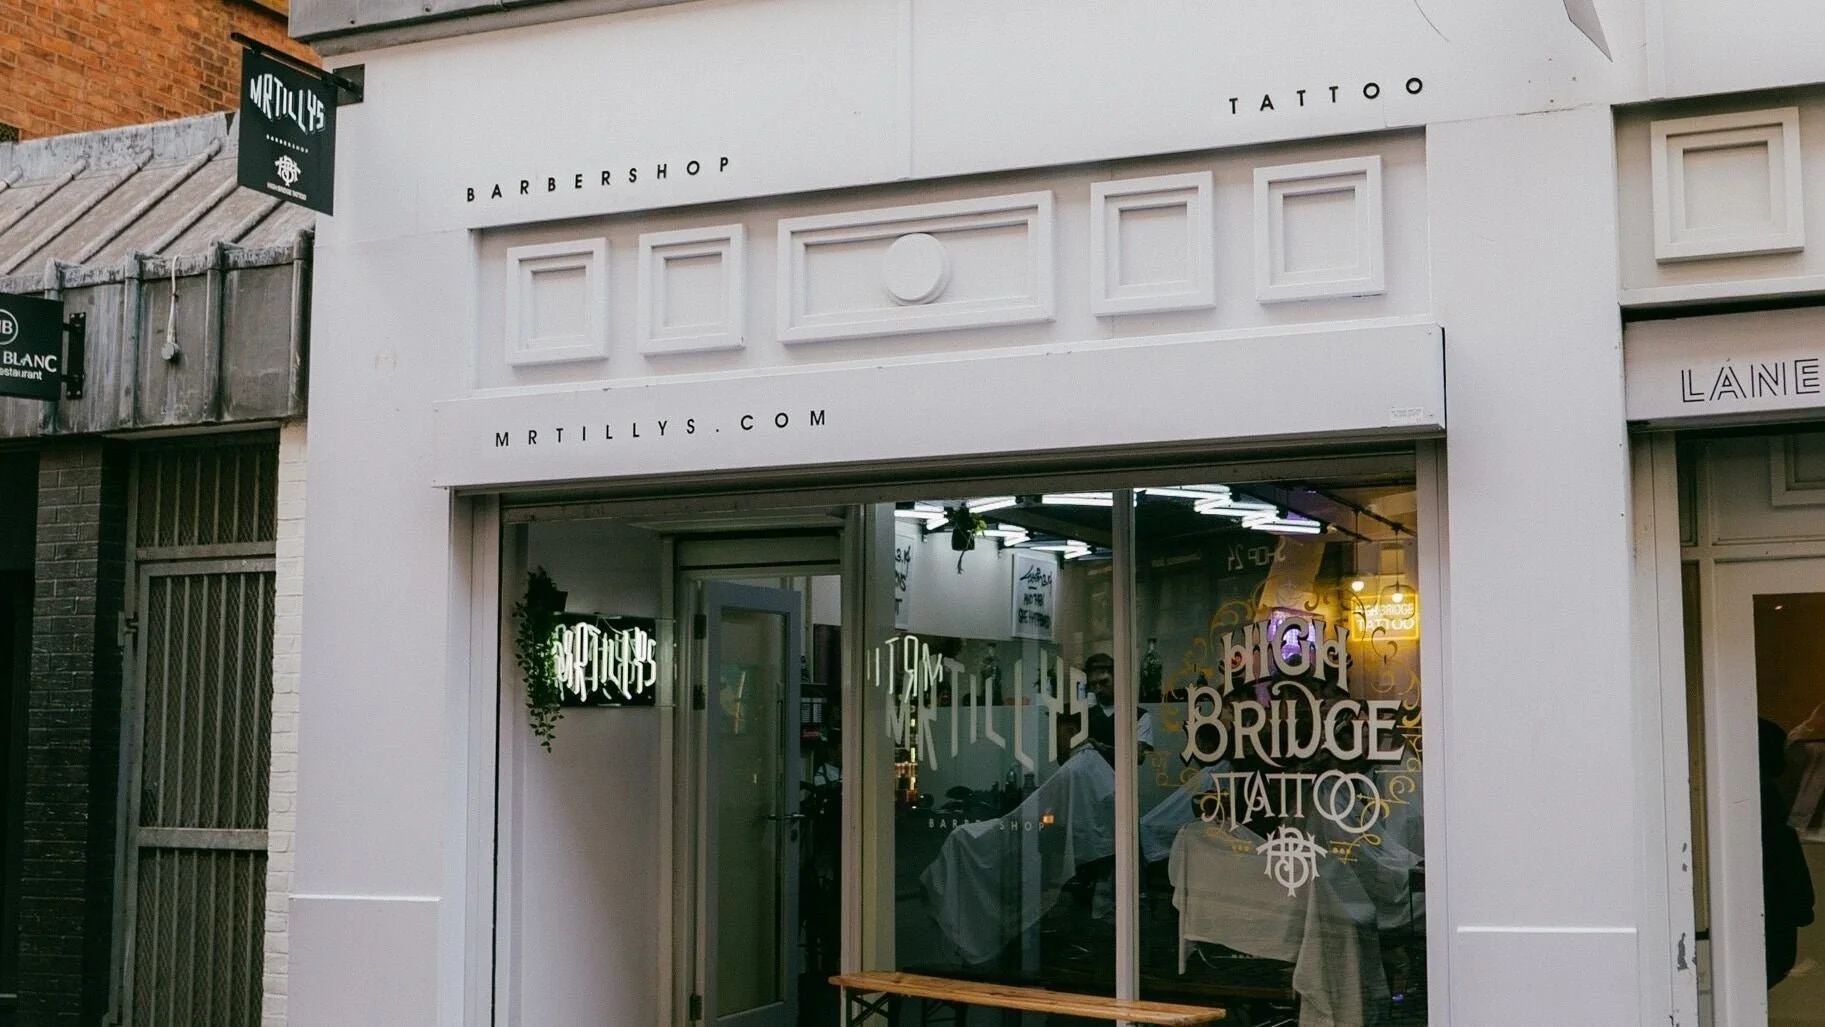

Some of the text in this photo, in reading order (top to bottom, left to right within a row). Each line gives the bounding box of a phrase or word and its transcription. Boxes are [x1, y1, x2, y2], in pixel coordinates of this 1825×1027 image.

[250, 73, 325, 134] MRTILLYS
[1228, 77, 1423, 115] TATTOO
[466, 156, 729, 202] BARBERSHOP
[0, 319, 13, 335] B
[3, 350, 57, 373] BLANC
[1681, 358, 1820, 403] LANE
[495, 409, 826, 448] MRTILLYS.COM
[1356, 617, 1416, 632] TATTOO
[1220, 617, 1353, 697] HIGH
[886, 648, 1089, 773] MRTILLYS
[1180, 680, 1406, 767] BRIDGE
[1200, 769, 1381, 833] TATTOO
[928, 818, 1045, 832] BARBSHOP
